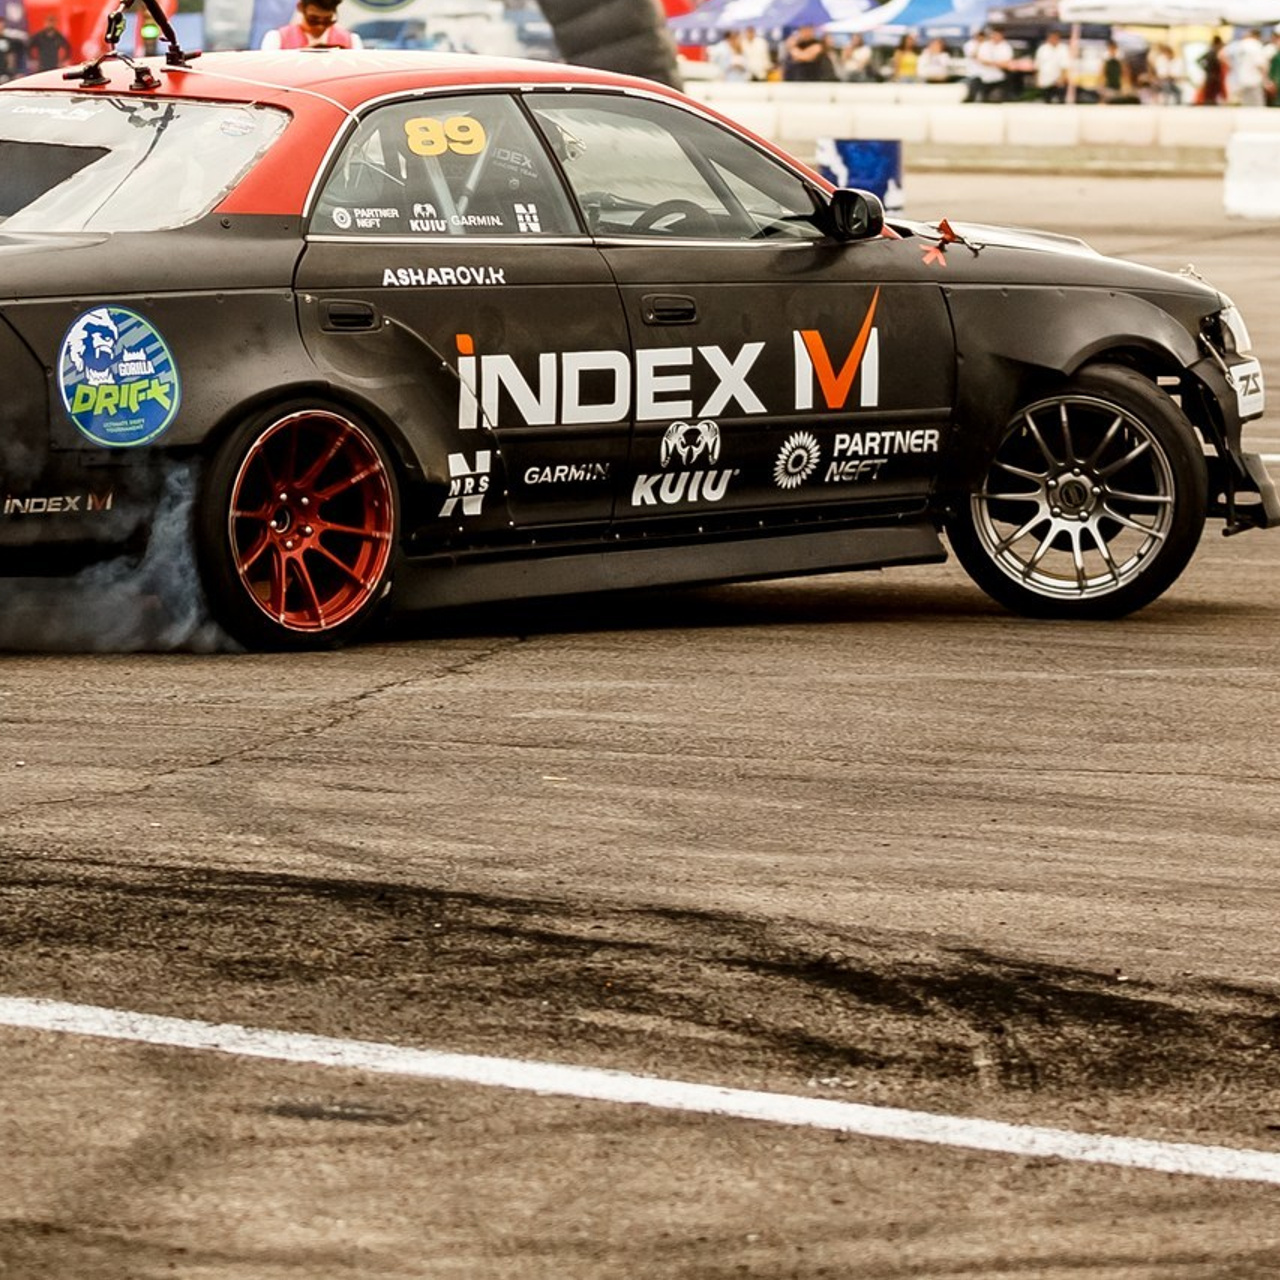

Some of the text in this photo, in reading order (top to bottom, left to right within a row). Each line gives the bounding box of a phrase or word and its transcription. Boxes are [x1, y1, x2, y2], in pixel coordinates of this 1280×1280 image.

[404, 117, 486, 156] 89
[354, 208, 399, 219] PARTNER
[357, 219, 381, 229] NEFT
[410, 220, 447, 232] KUIU
[118, 360, 155, 376] GORILLA
[72, 378, 172, 416] DRIFT
[833, 429, 940, 457] PARTNER
[524, 462, 610, 485] GARMIN
[824, 458, 887, 482] NEFT
[449, 476, 490, 497] NRS
[631, 469, 734, 506] KUIU
